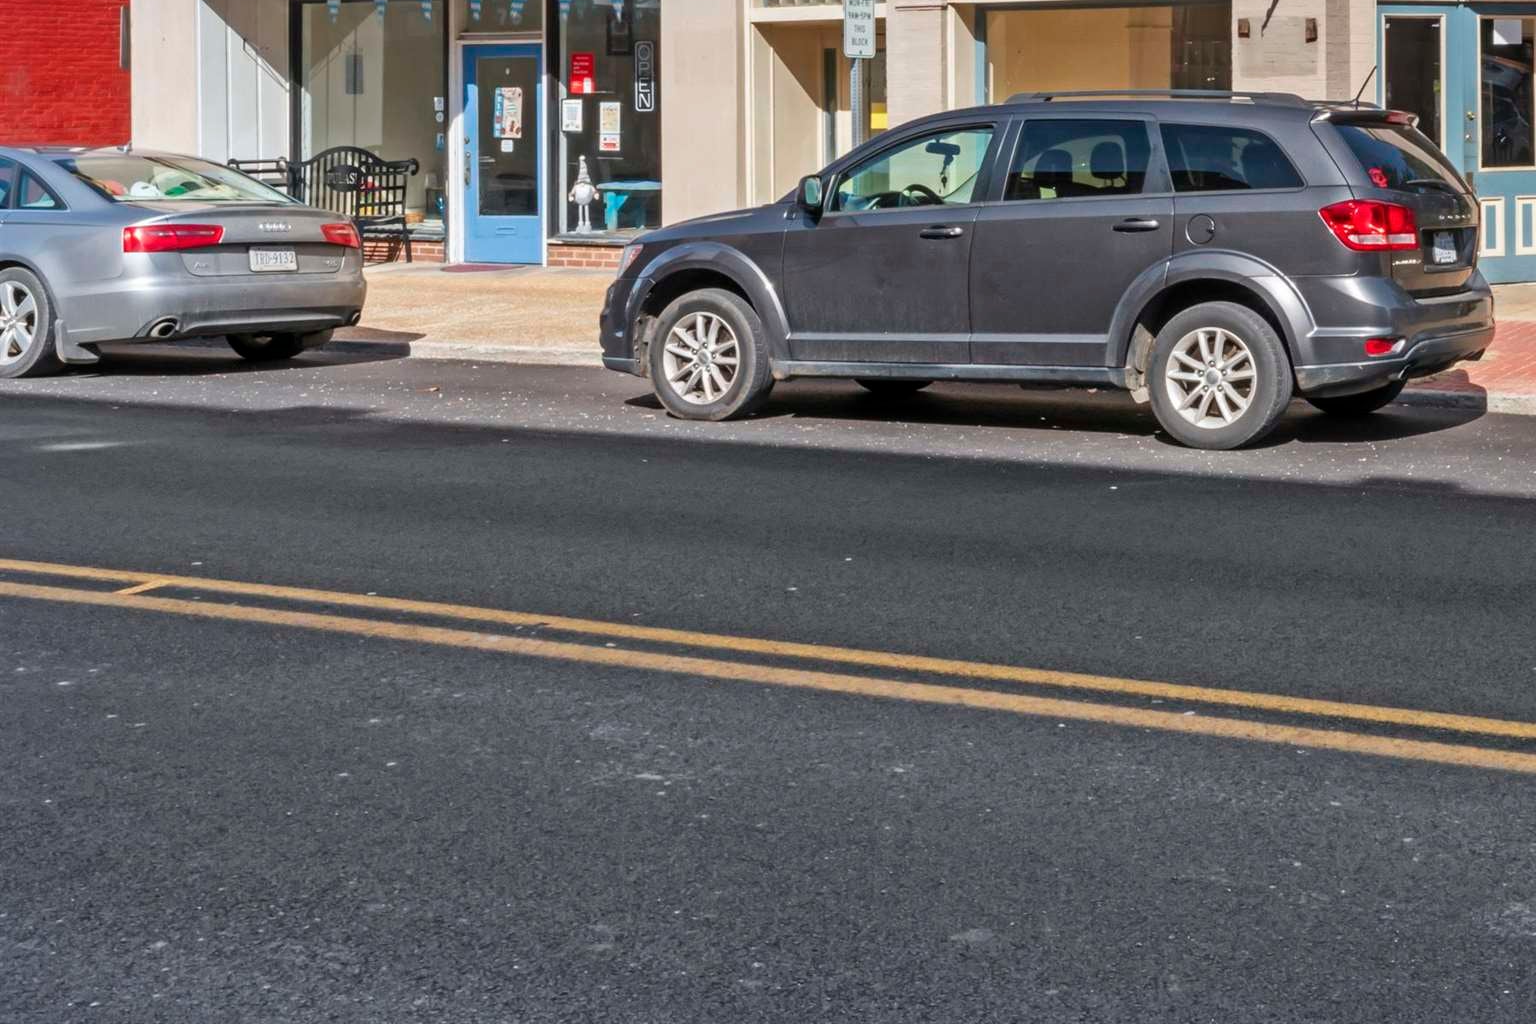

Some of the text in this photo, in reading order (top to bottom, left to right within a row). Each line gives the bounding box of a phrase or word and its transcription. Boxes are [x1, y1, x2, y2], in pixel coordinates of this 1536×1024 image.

[854, 23, 866, 33] THIS
[851, 37, 869, 47] BLOCK
[638, 44, 652, 108] OPEN
